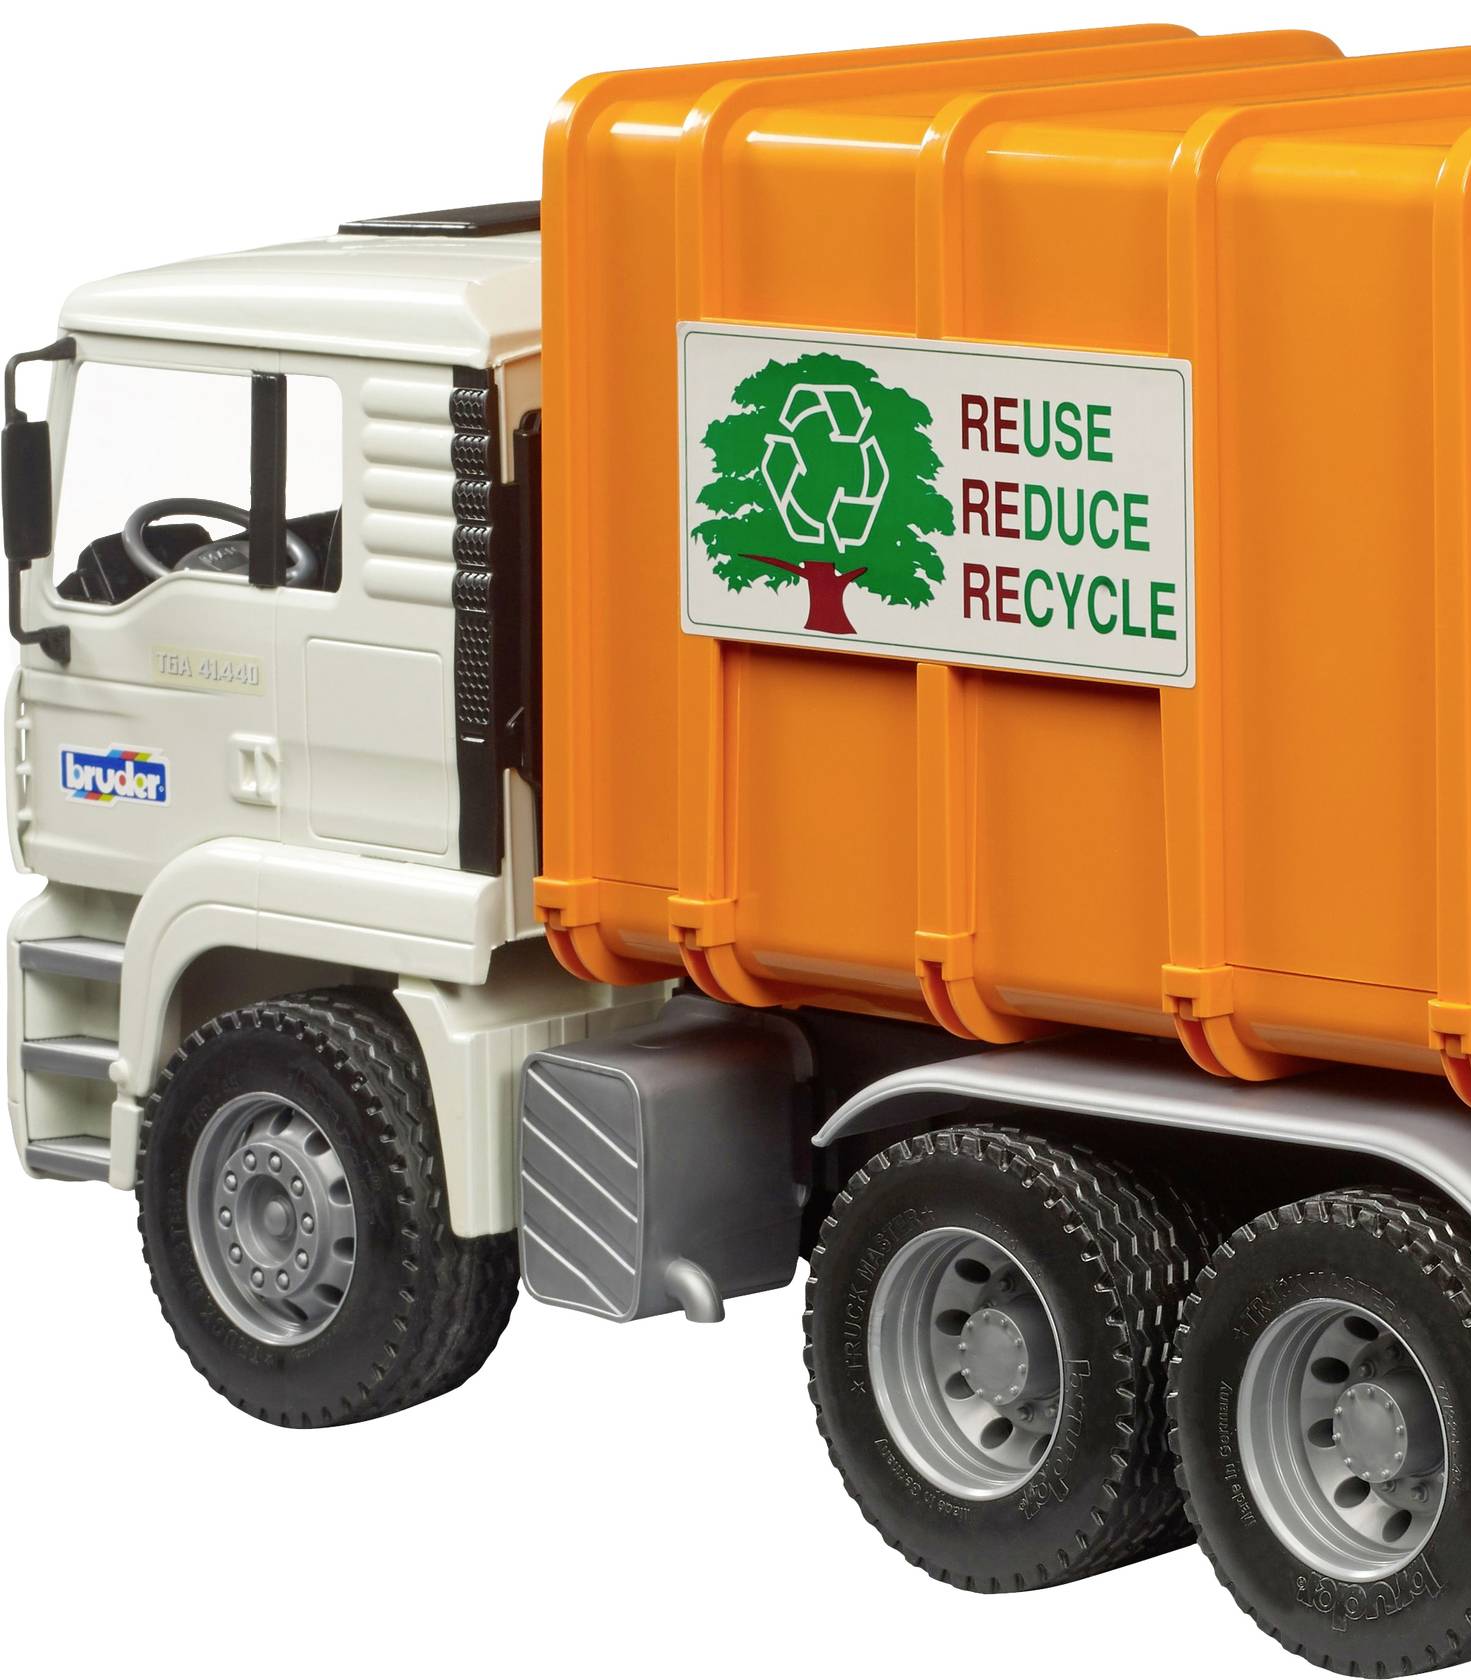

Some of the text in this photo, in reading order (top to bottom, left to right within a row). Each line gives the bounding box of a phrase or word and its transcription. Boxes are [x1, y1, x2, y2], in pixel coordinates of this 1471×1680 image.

[961, 393, 1114, 463] REUSE
[962, 478, 1151, 552] REDUCE
[962, 562, 1178, 640] RECYCLE
[156, 652, 193, 678] TGA
[66, 752, 161, 799] bruder
[844, 1208, 922, 1375] TRUCK MASTER
[1218, 1380, 1233, 1458] Germany
[1230, 1483, 1257, 1528] Made
